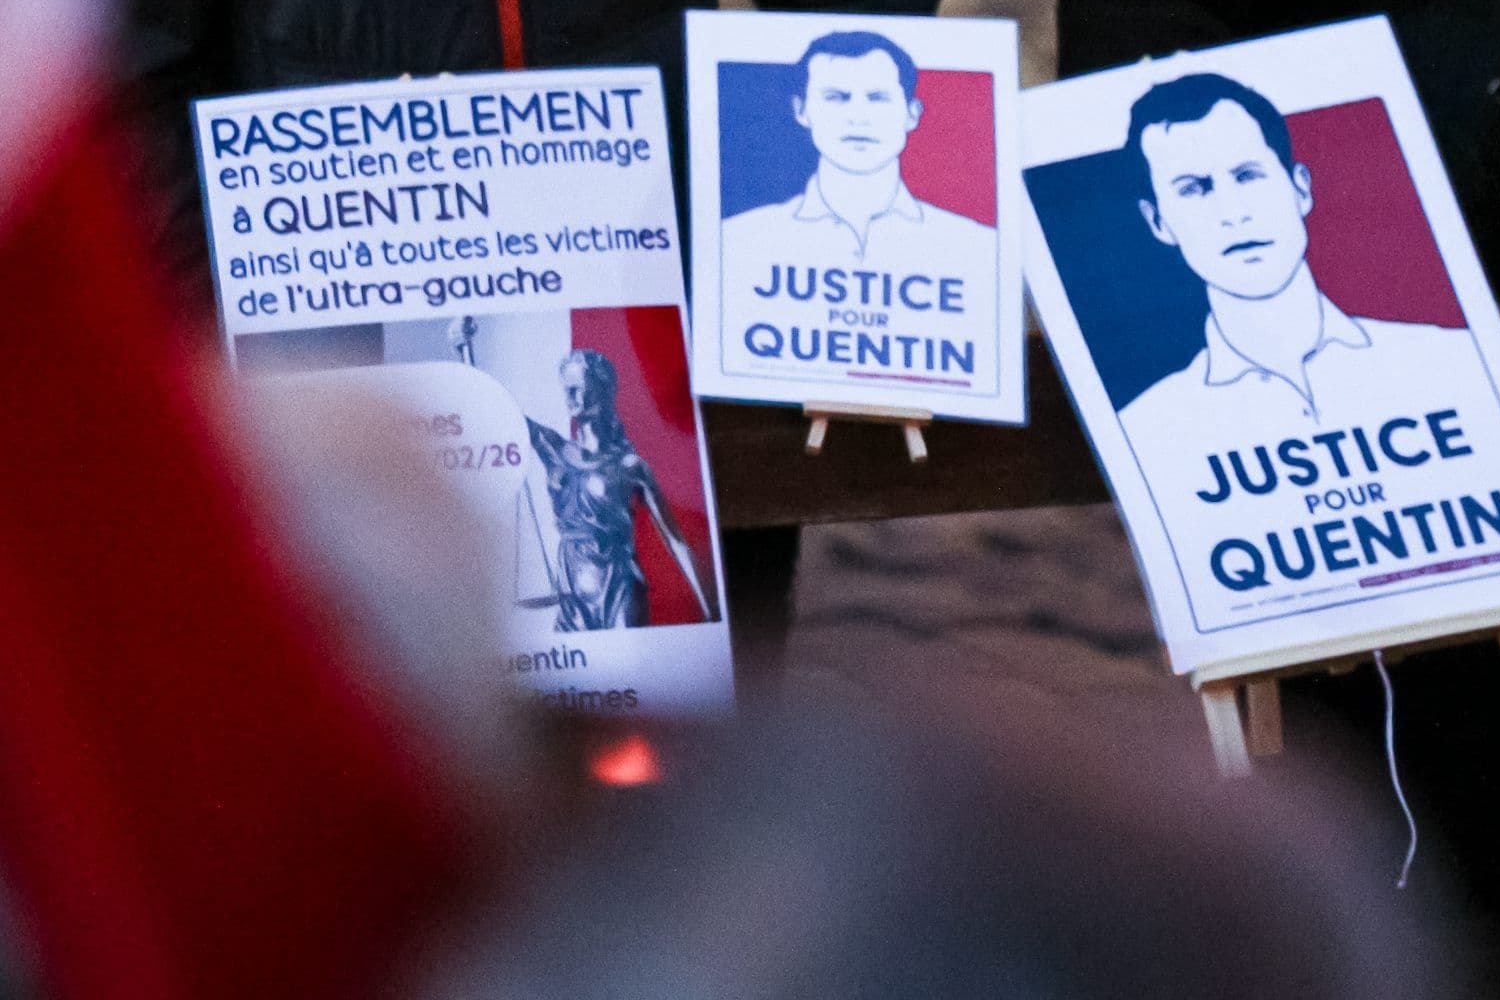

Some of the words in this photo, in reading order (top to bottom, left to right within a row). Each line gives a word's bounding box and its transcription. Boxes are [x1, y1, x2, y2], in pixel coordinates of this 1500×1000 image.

[211, 88, 642, 158] RASSEMBLEMENT
[218, 163, 260, 190] en
[270, 149, 398, 185] soutien
[407, 145, 439, 171] et
[453, 141, 492, 168] en
[501, 135, 651, 167] hommage
[233, 204, 252, 233] à
[263, 180, 490, 235] QUENTIN
[229, 251, 300, 279] ainsi
[309, 240, 373, 275] qu'à
[383, 229, 489, 264] toutes
[498, 228, 539, 257] les
[546, 222, 671, 253] victimes
[238, 286, 279, 317] de
[286, 266, 563, 312] l'ultra-gauche
[753, 265, 965, 314] JUSTICE
[828, 309, 889, 329] POUR
[744, 322, 975, 374] QUENTIN
[1197, 409, 1473, 503] JUSTICE
[1304, 482, 1386, 515] POUR
